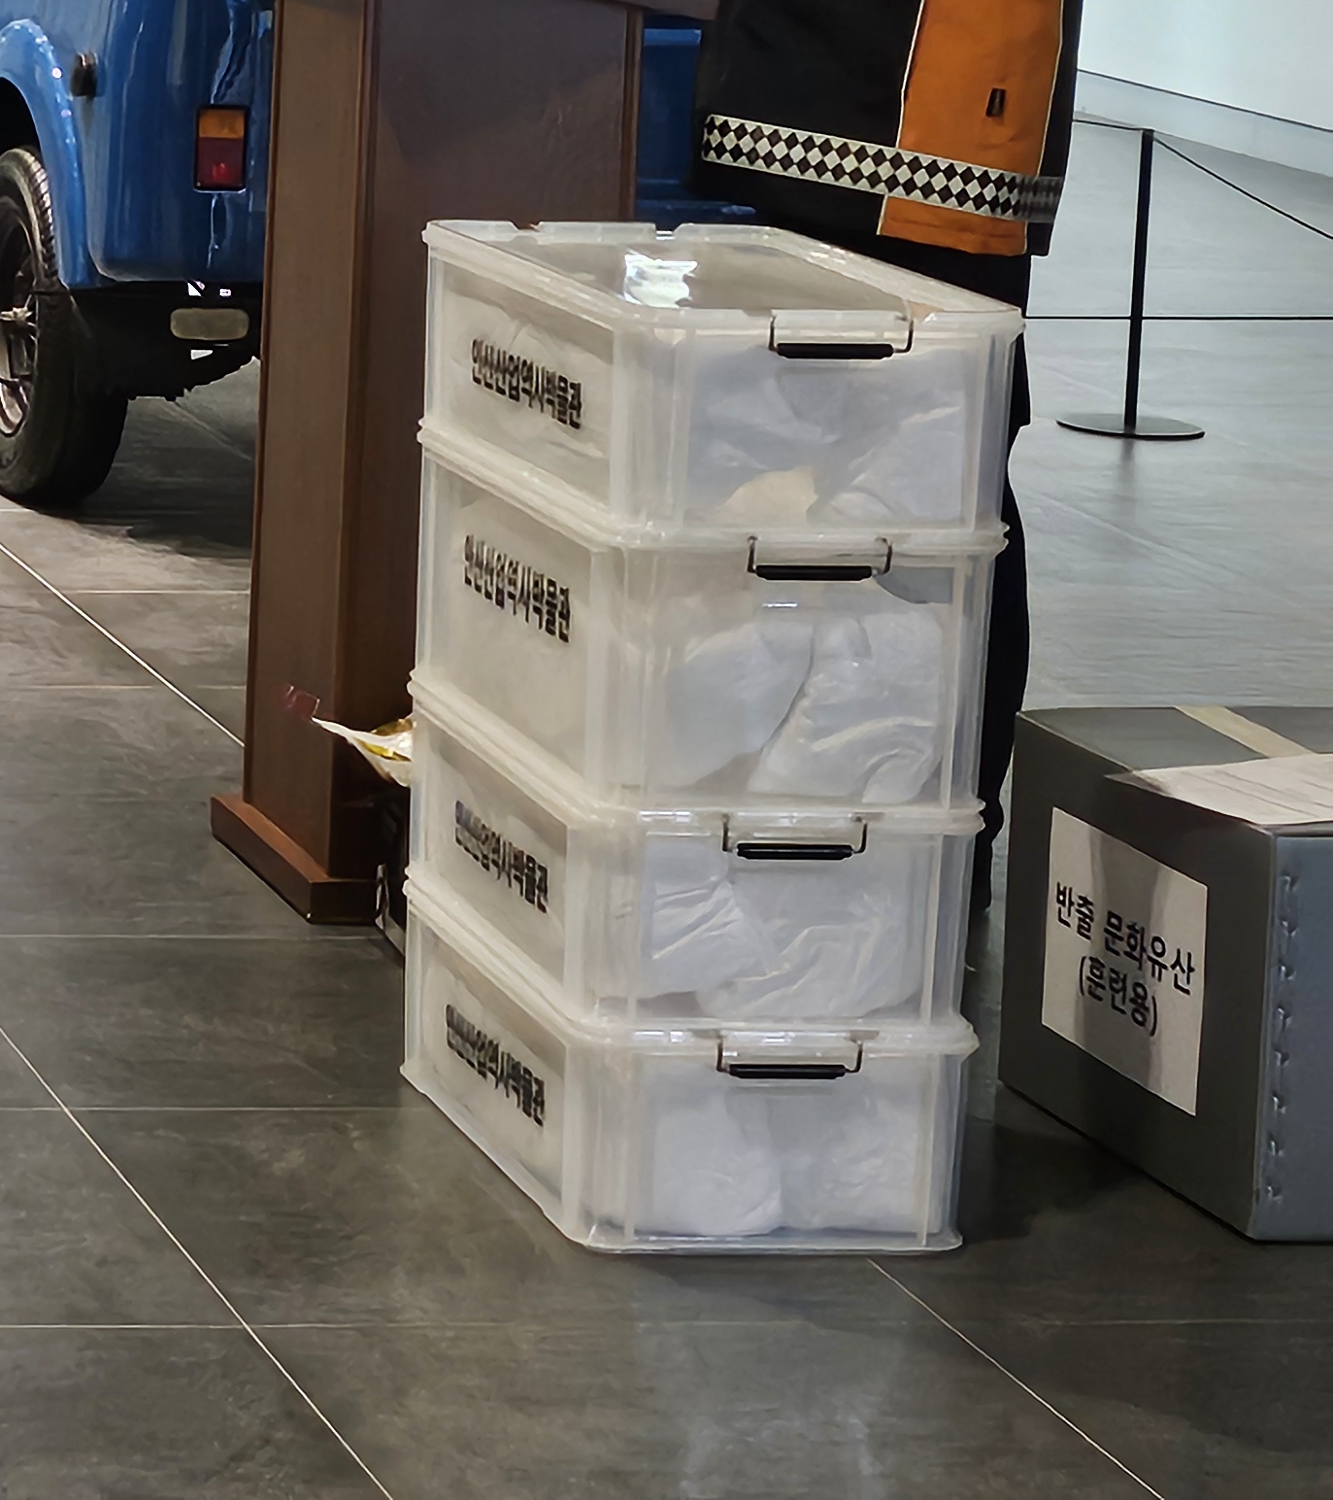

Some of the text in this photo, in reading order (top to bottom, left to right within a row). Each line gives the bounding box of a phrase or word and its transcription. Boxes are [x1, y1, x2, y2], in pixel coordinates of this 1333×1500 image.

[1056, 881, 1196, 996] 반출 문화유산
[1079, 955, 1158, 1037] (훈련용)
